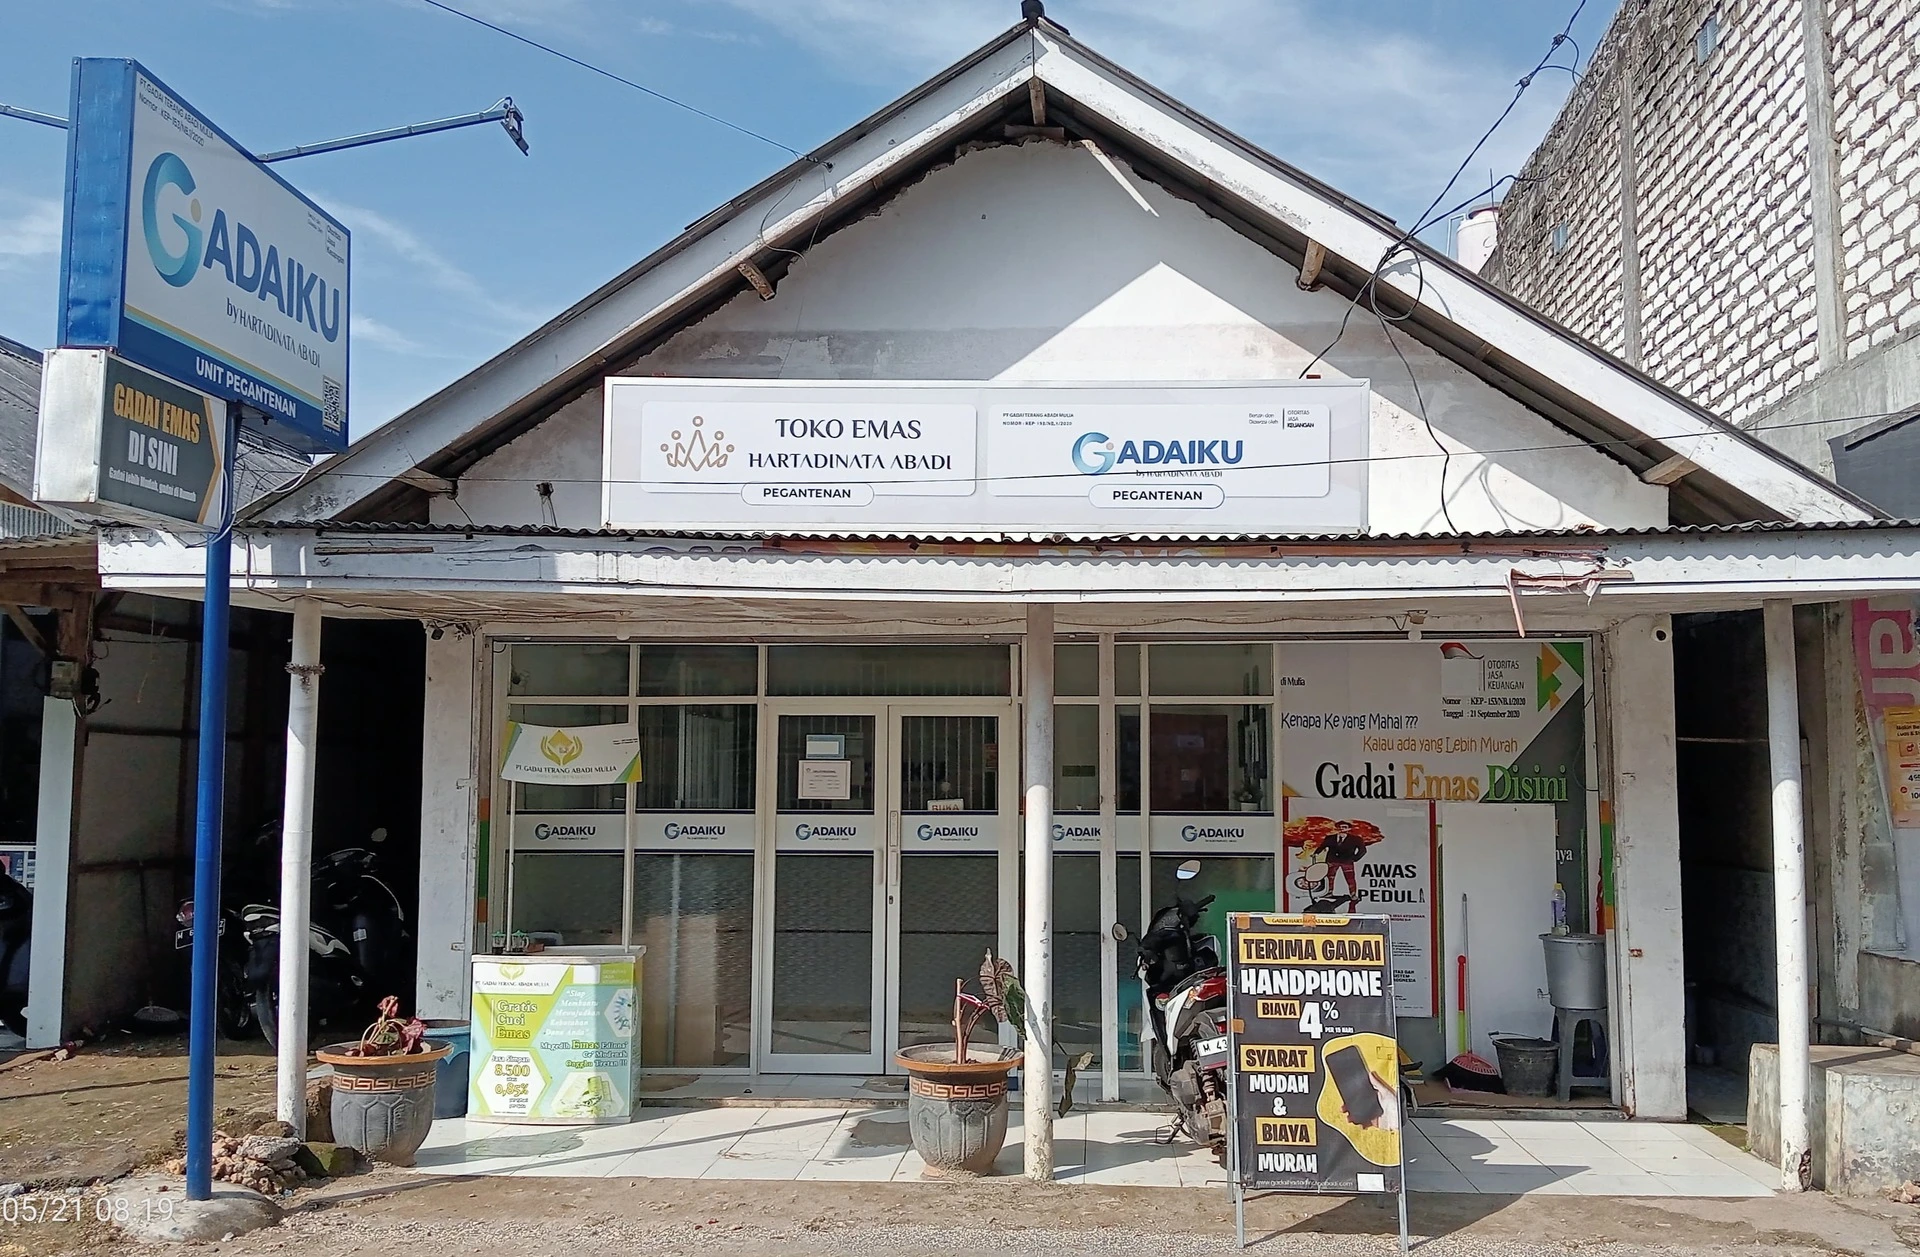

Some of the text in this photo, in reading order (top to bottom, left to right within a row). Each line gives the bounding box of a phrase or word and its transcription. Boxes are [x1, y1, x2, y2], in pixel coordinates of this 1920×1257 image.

[142, 152, 340, 343] GADAIKU
[226, 297, 320, 369] by HARTADINATA ABADI
[196, 356, 297, 419] UNIT PEGANTENAN
[113, 383, 201, 444] GADAI EMAS
[775, 418, 922, 440] TOKO EMAS
[128, 430, 179, 476] DI SINI
[749, 452, 952, 471] HARTADINATA ABADI
[1072, 432, 1243, 476] GADAIKU
[762, 487, 852, 500] PEGANTENAN
[1112, 490, 1203, 501] PEGANTENAN
[1487, 660, 1520, 670] OTORITAS
[1487, 671, 1504, 680] JASA
[1487, 681, 1525, 690] KEUANGAN
[1281, 712, 1419, 731] Kenapa Ke yang Mahal ???
[1441, 709, 1464, 719] Tanggal
[1477, 709, 1507, 720] September
[1363, 736, 1518, 754] Kalau ada yang Lebih Murah
[571, 766, 593, 774] ABADI
[1315, 762, 1569, 802] Gadai Emas Disini
[535, 823, 596, 841] GADAIKU
[664, 822, 726, 840] GADAIKU
[795, 823, 857, 841] GADAIKU
[917, 824, 978, 841] GADAIKU
[1181, 825, 1245, 843] GADAIKU
[1361, 863, 1417, 878] AWAS
[1369, 878, 1396, 888] DAN
[1243, 938, 1318, 961] TERIMA
[1321, 939, 1382, 962] GADAI
[1240, 968, 1384, 998] HANDPHONE
[497, 1000, 537, 1012] Gratis
[1261, 1002, 1297, 1016] BIAYA
[496, 1013, 525, 1025] Cuci
[496, 1026, 530, 1039] Emas
[571, 1039, 600, 1050] Emas
[1245, 1048, 1308, 1069] SYARAT
[494, 1063, 531, 1077] 8.500
[494, 1082, 529, 1097] 0,85%
[1249, 1074, 1310, 1094] MUDAH
[1272, 1096, 1288, 1116] &
[1261, 1123, 1311, 1143] BIAYA
[1257, 1153, 1318, 1174] MURAH
